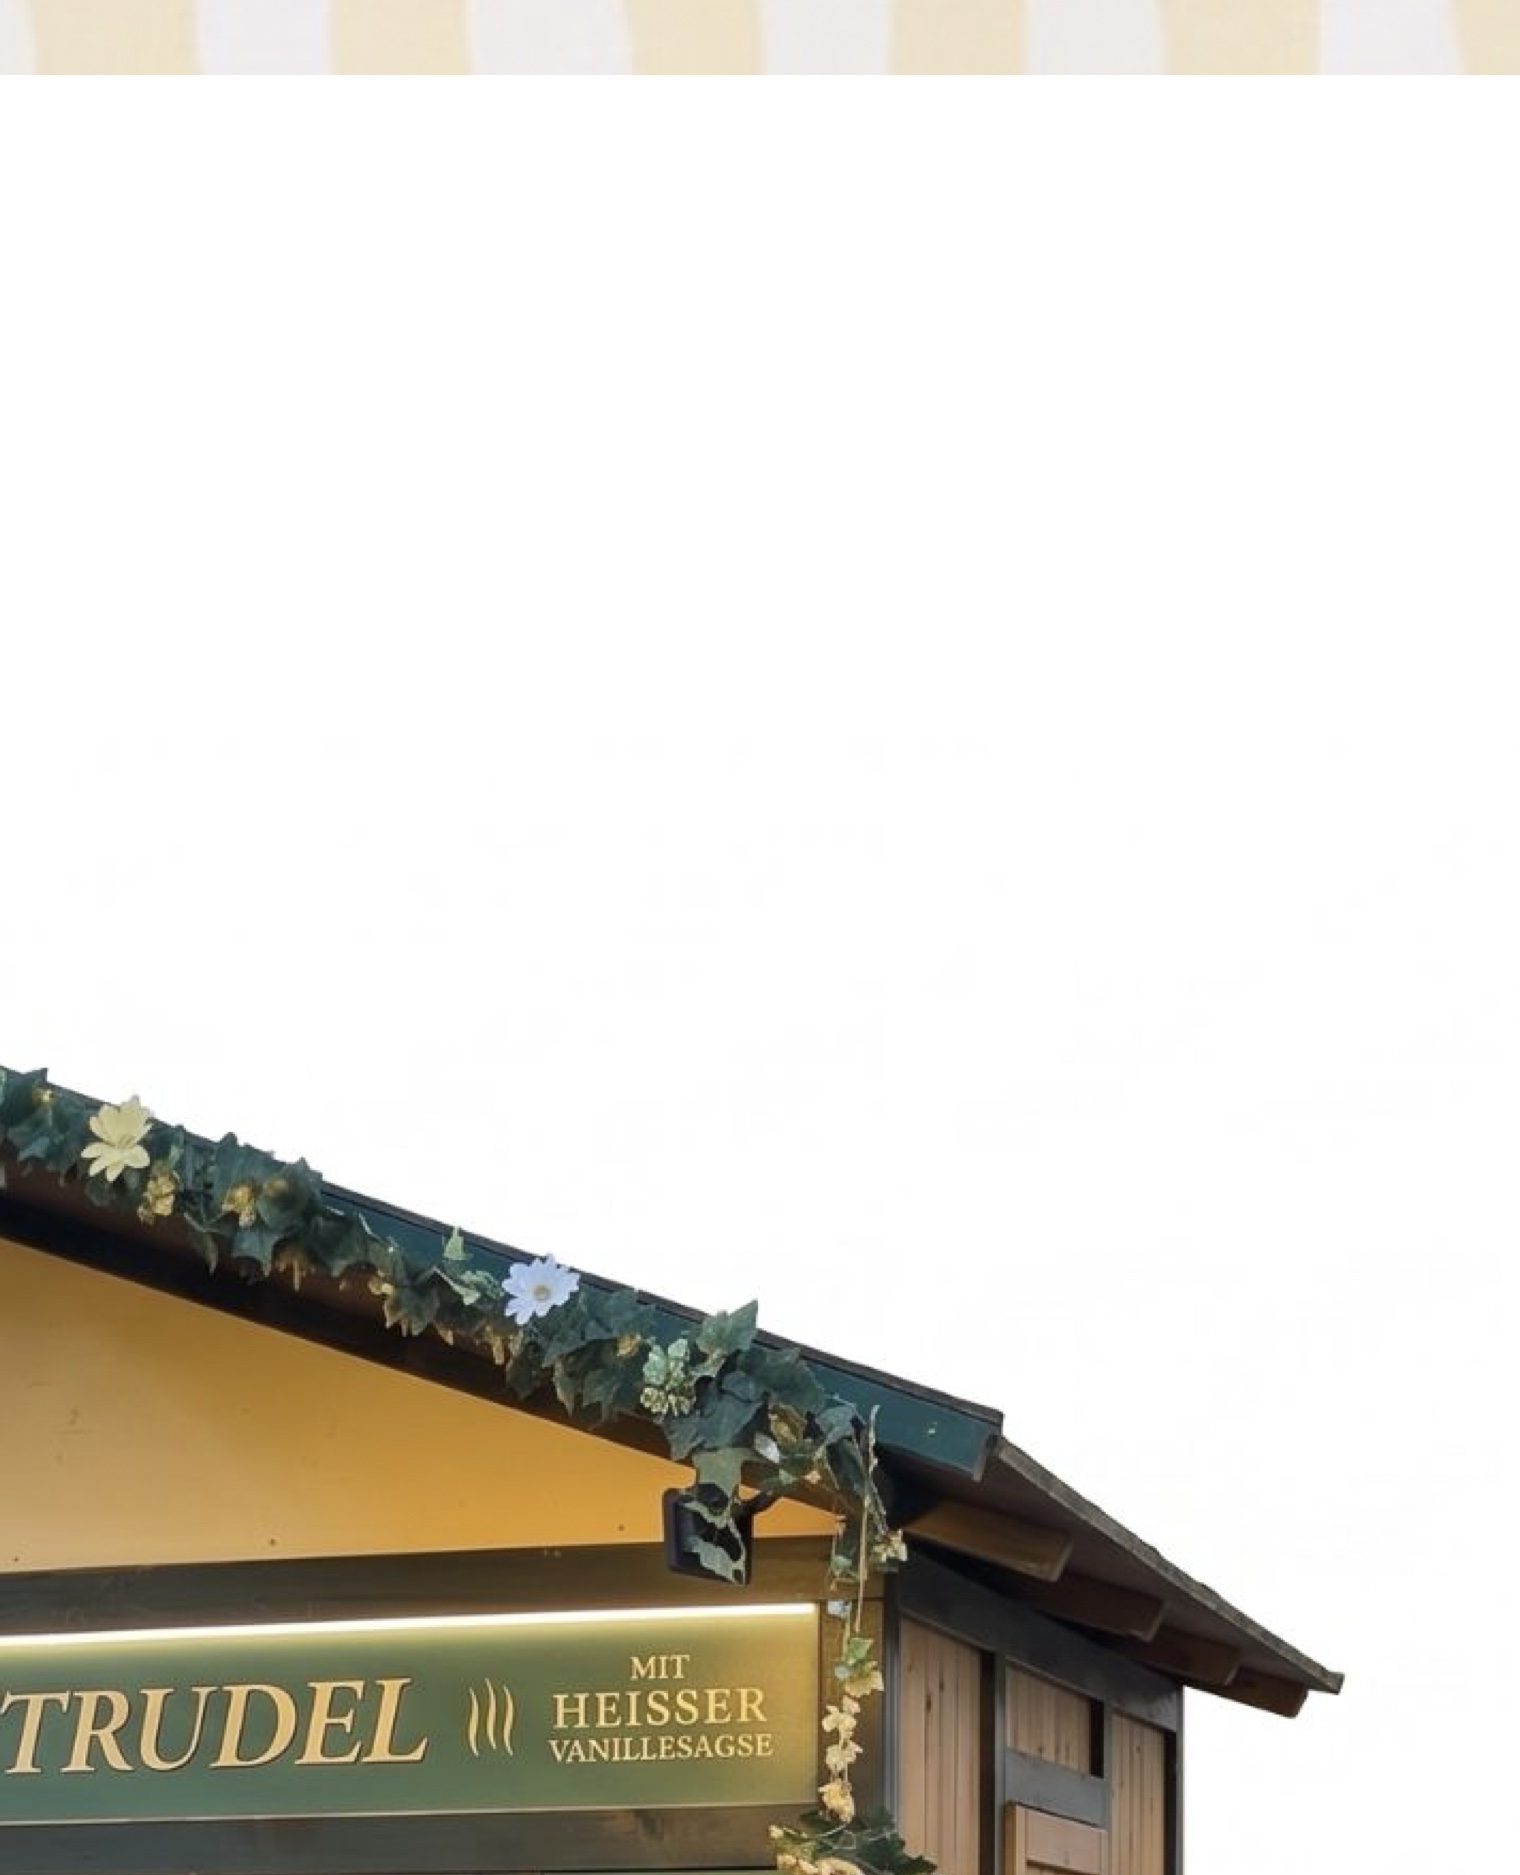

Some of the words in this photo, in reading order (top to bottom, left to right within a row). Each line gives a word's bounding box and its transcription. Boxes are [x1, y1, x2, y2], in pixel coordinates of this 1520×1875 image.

[630, 1654, 690, 1681] MIT
[552, 1687, 768, 1729] HEISSER
[548, 1733, 774, 1764] VANILLESAGSE
